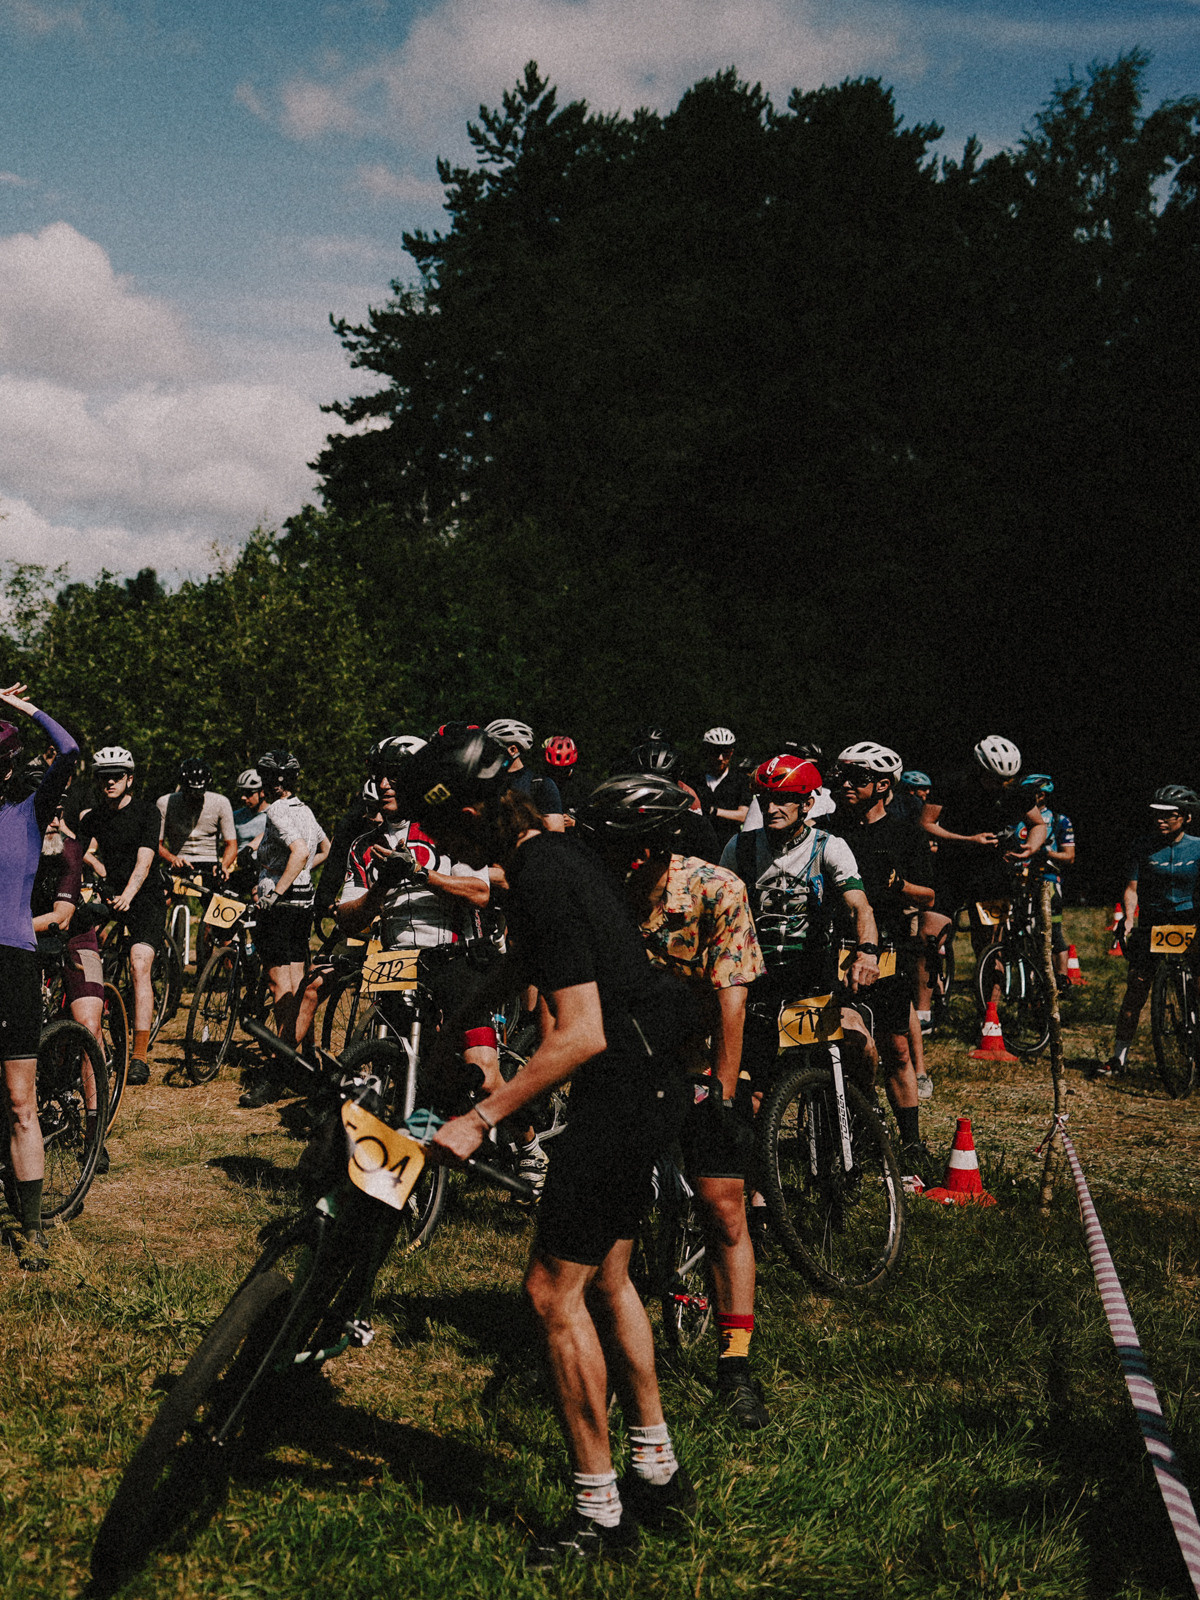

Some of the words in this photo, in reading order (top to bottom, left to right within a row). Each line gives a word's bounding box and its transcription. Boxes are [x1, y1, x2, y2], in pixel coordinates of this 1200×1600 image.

[212, 903, 237, 922] 60
[1155, 931, 1193, 947] 205
[376, 960, 404, 983] 712
[346, 1121, 411, 1188] 104
